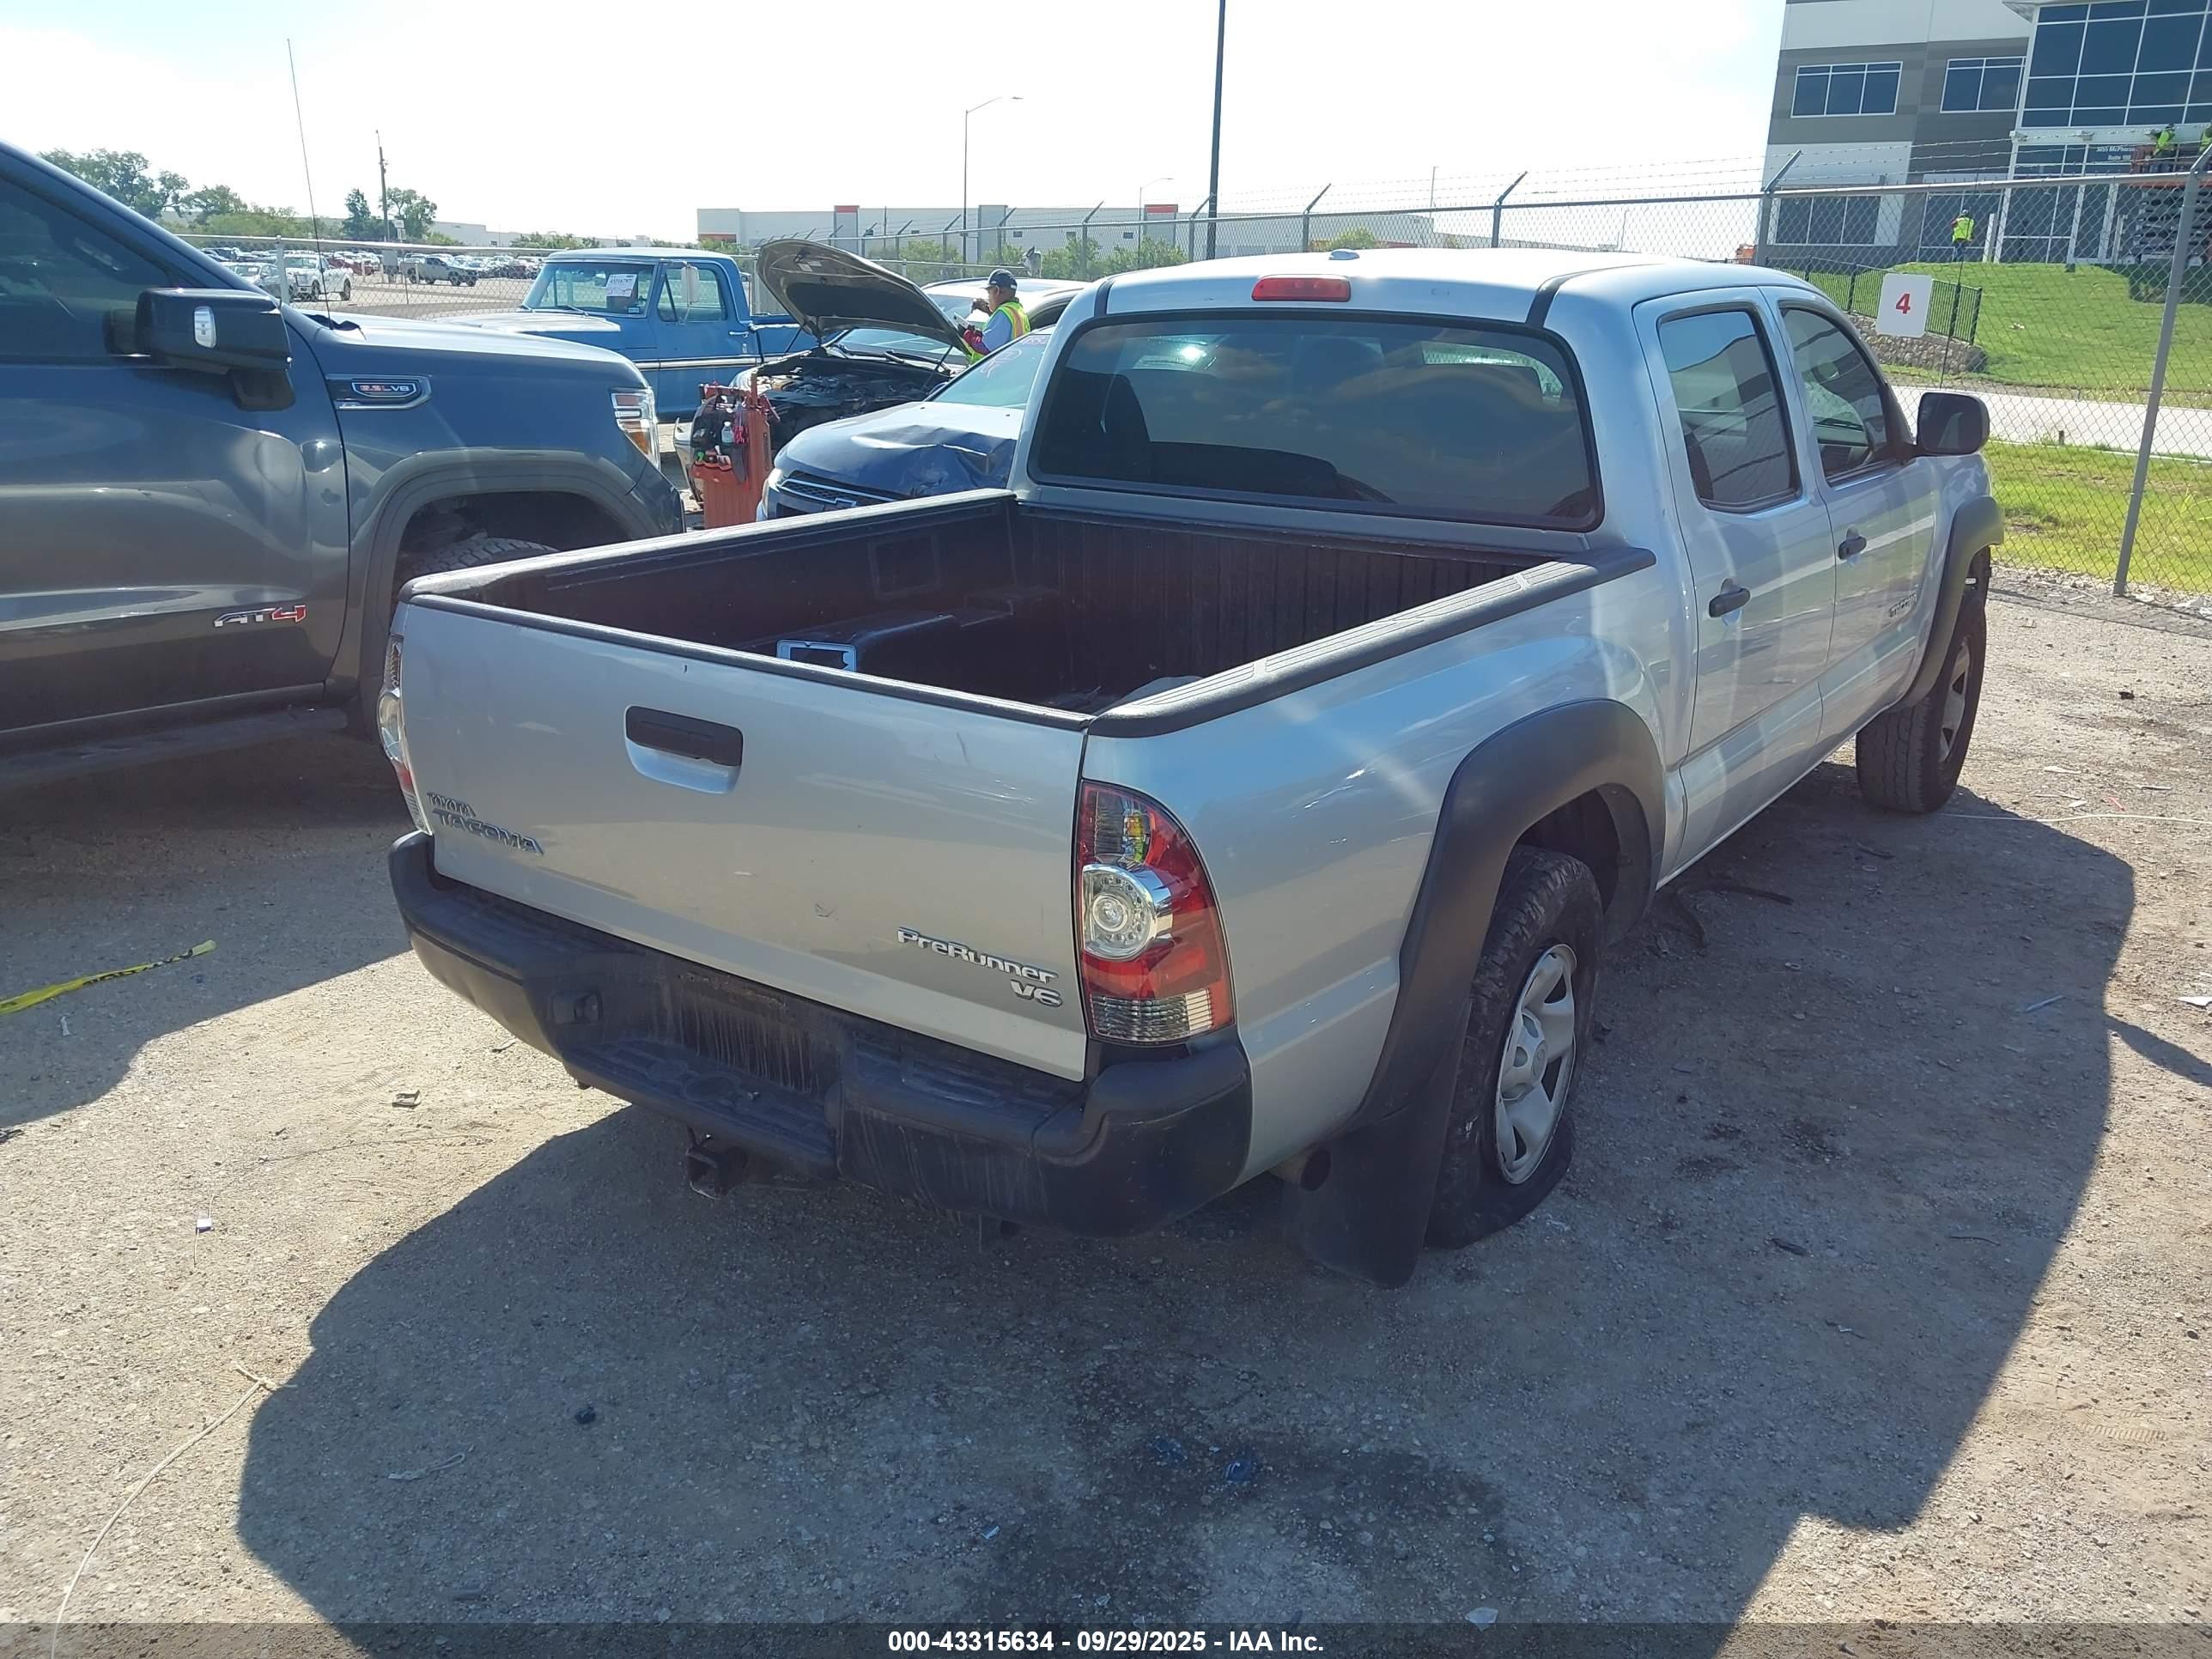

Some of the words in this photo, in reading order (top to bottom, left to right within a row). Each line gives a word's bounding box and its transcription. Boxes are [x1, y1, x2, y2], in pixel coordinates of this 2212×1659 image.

[1895, 293, 1911, 315] 4
[213, 605, 307, 628] AT4
[427, 791, 477, 818] TOYOTA
[433, 807, 544, 856] TACOMA
[896, 927, 1059, 984] PreRunner
[1010, 978, 1064, 1007] V6
